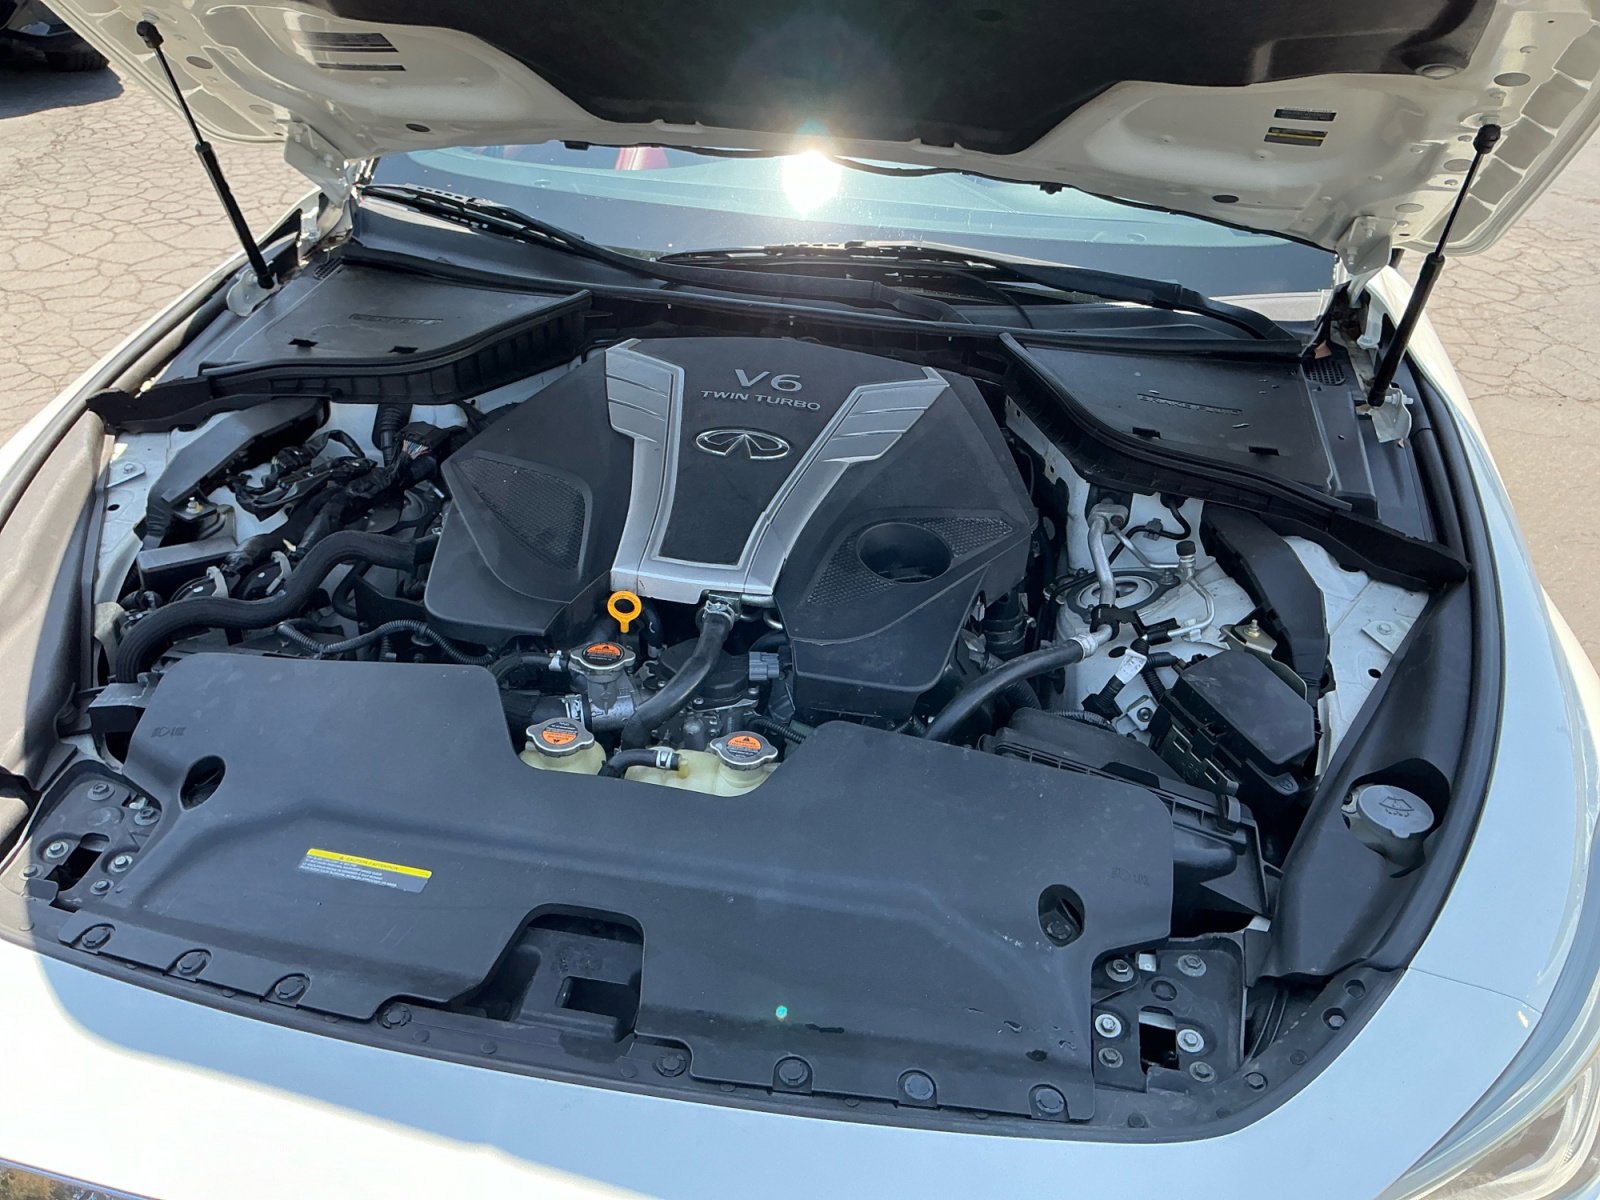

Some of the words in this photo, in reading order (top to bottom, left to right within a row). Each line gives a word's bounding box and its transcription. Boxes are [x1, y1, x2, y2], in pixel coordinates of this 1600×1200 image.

[735, 369, 802, 391] V6
[701, 390, 749, 400] TWIN
[755, 395, 820, 410] TURBO
